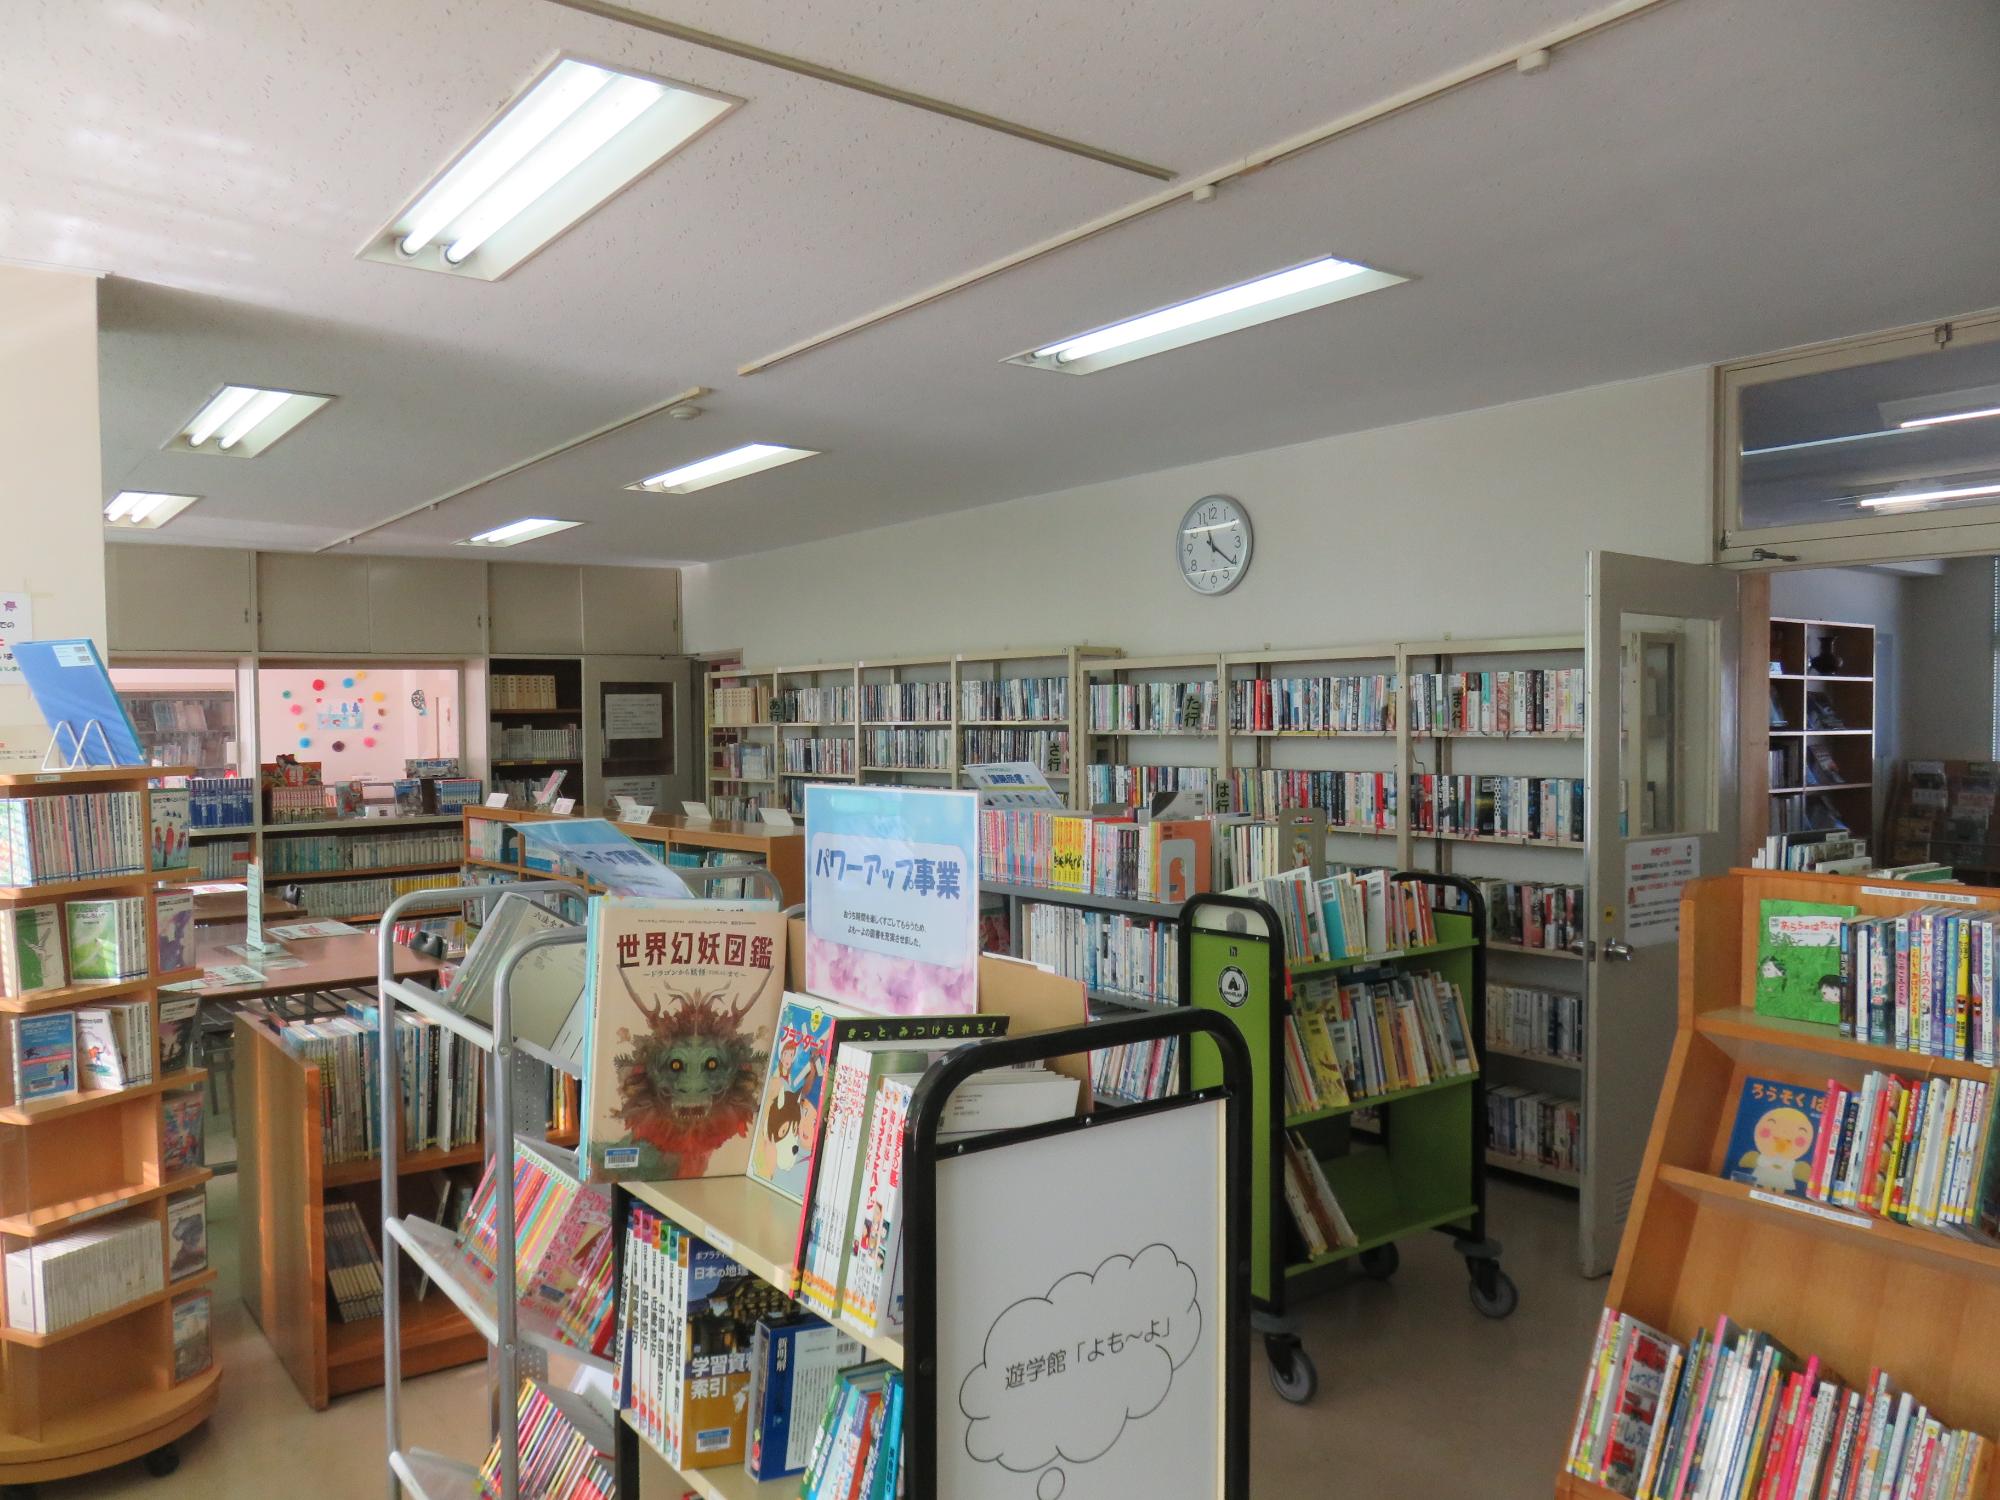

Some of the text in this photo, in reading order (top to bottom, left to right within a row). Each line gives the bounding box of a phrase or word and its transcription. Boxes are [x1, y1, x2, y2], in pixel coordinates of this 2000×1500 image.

[1197, 511, 1207, 525] 11
[1208, 506, 1217, 520] 12
[1186, 543, 1193, 556] 9
[1234, 536, 1242, 549] 3
[1190, 559, 1198, 572] 8
[1231, 554, 1238, 565] 4
[1210, 571, 1218, 585] 6
[1222, 567, 1230, 580] 5
[1183, 695, 1202, 729] た行
[1047, 742, 1061, 772] さ行
[1215, 782, 1231, 814] は行
[816, 848, 961, 900] パワーアップ事業
[617, 931, 774, 969] 世界幻妖図鑑
[694, 1264, 749, 1281] 日本の地理
[691, 1378, 727, 1401] 索引
